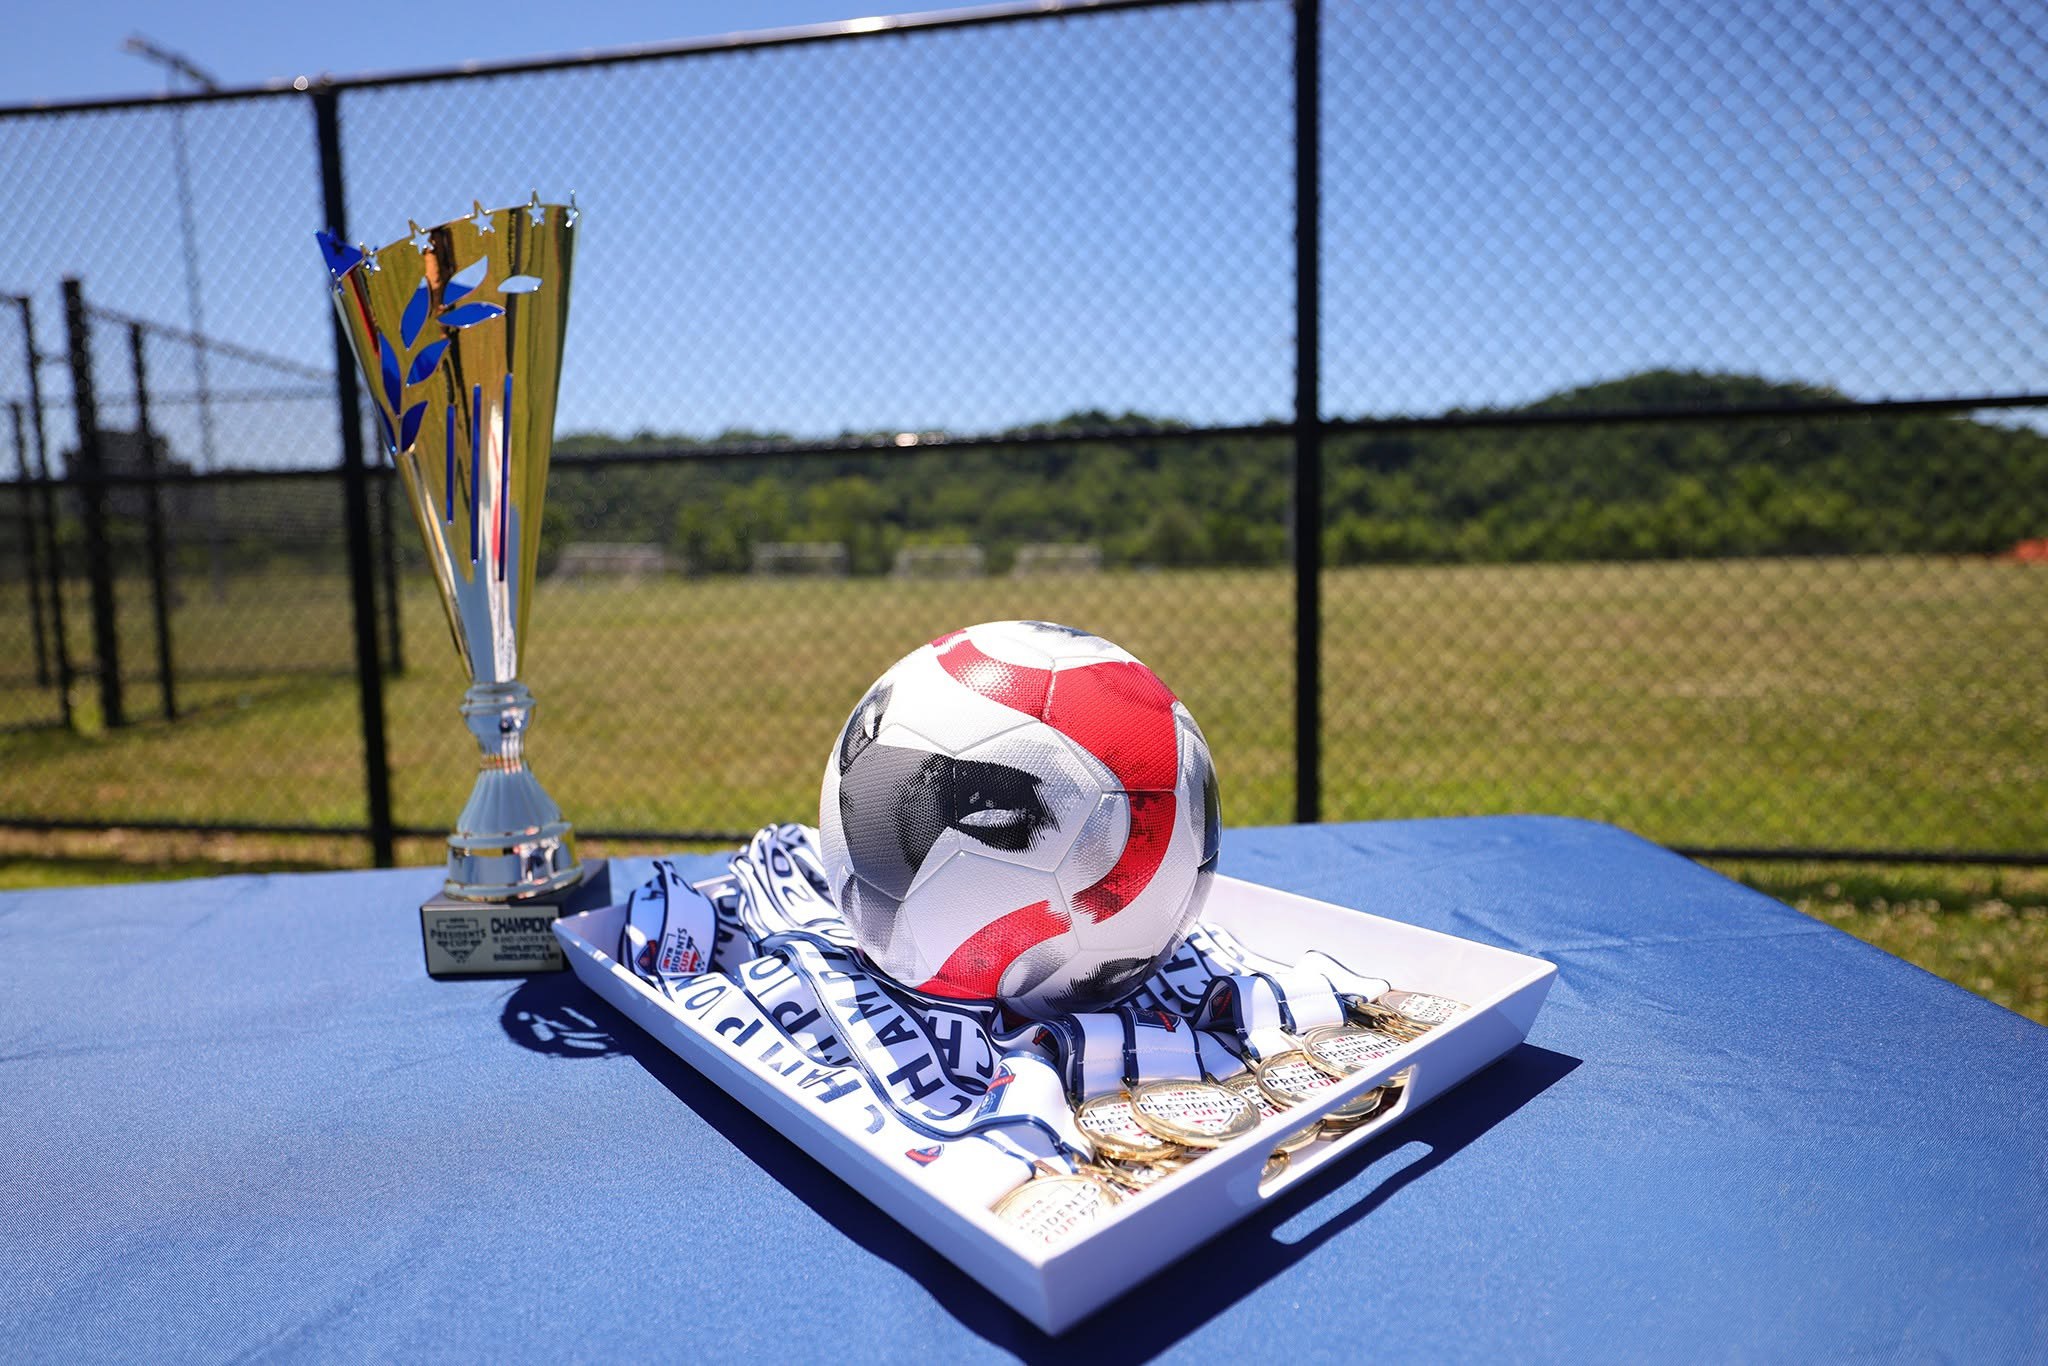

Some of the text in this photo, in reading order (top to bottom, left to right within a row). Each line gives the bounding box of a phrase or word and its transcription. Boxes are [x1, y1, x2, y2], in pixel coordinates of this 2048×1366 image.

[430, 928, 487, 939] PRESIDENTS
[679, 950, 690, 972] CUP
[1316, 1038, 1401, 1060] PRESIDENTS
[1357, 1051, 1385, 1062] CUP
[1139, 1097, 1246, 1113] PRESIDENTS
[1183, 1108, 1218, 1118] CUP
